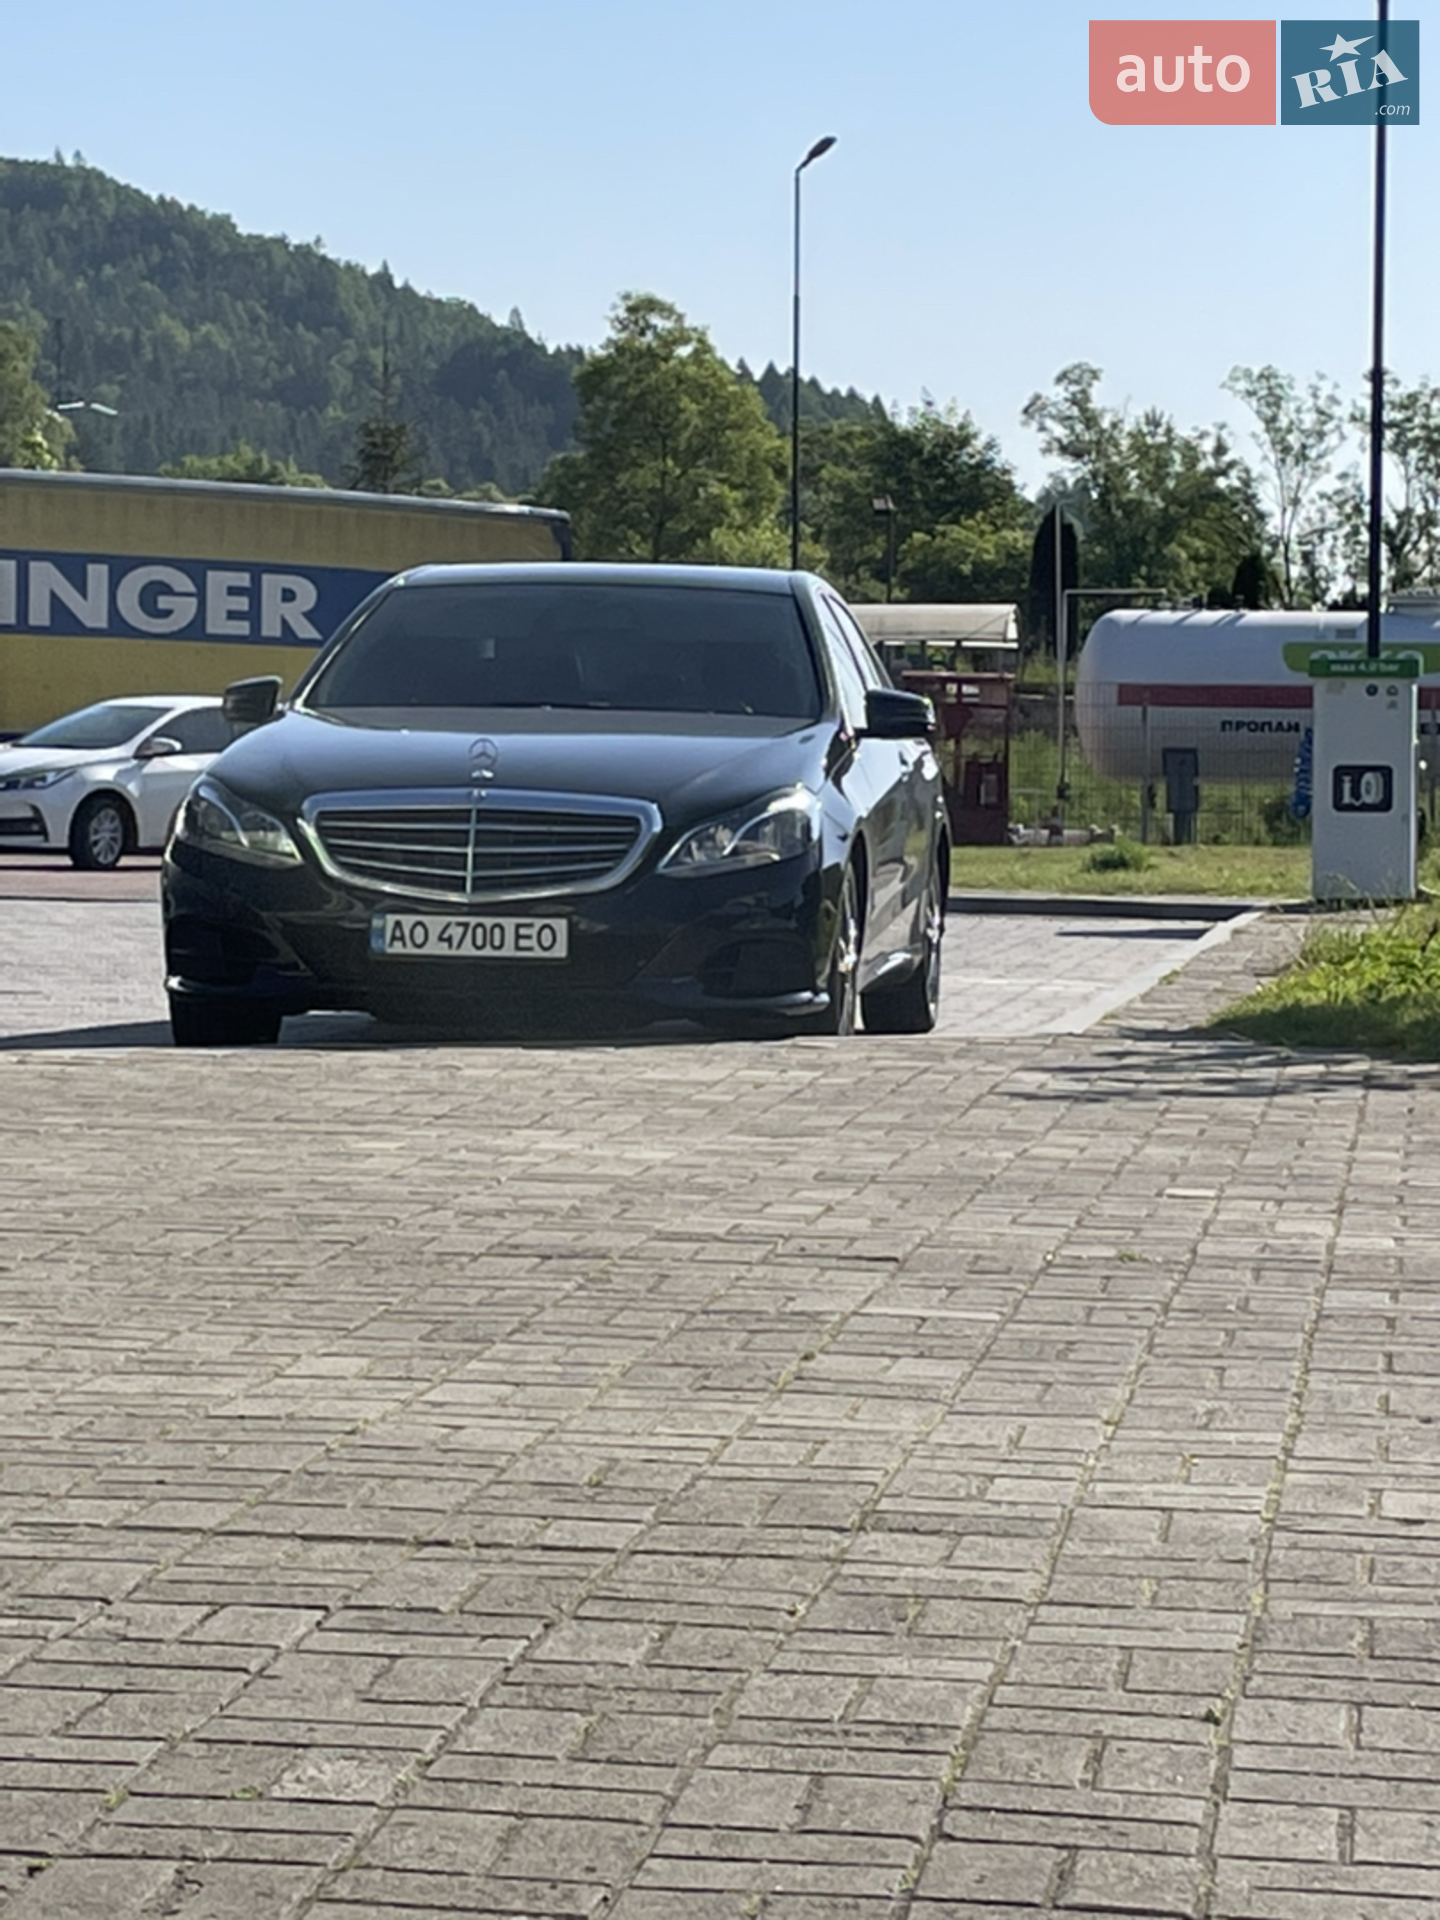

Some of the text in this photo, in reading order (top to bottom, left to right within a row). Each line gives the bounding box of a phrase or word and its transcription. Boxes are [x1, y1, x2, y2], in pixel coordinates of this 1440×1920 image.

[0, 559, 323, 641] INGER
[1221, 720, 1300, 733] ПРОПАН
[388, 919, 558, 951] AO 4700 EO
